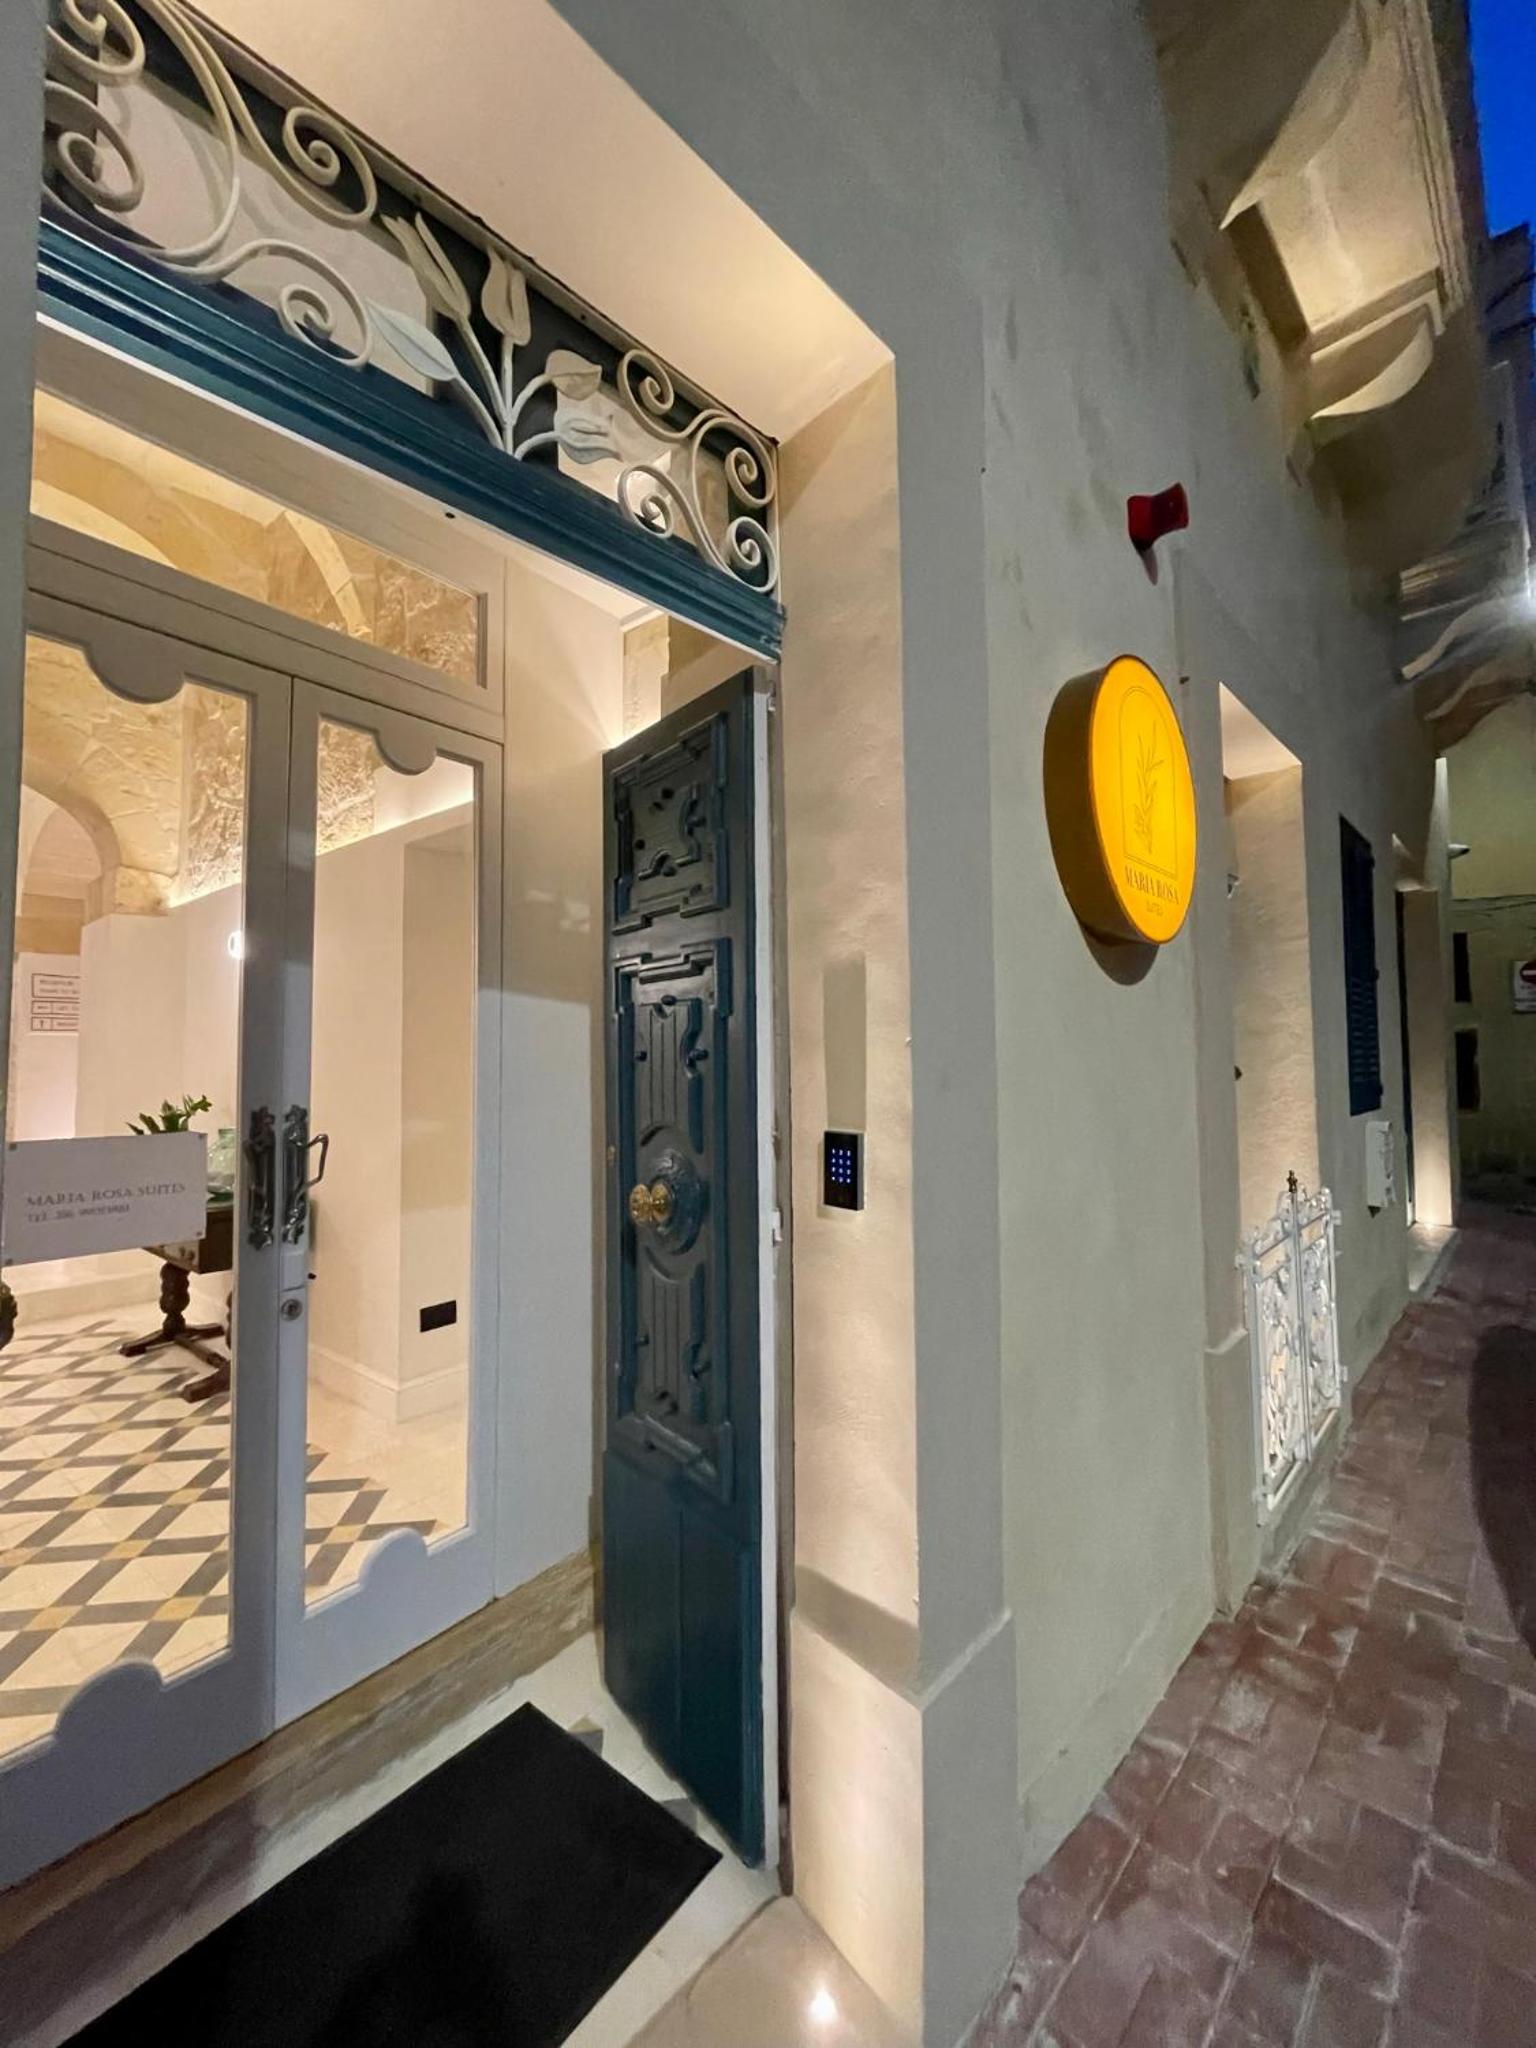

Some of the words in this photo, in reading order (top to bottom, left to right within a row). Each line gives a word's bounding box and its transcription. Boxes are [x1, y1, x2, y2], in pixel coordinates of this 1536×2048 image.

[1124, 865, 1155, 897] MARIA
[1156, 879, 1179, 904] ROSA
[27, 1192, 85, 1206] MARIA
[92, 1188, 132, 1201] ROSA
